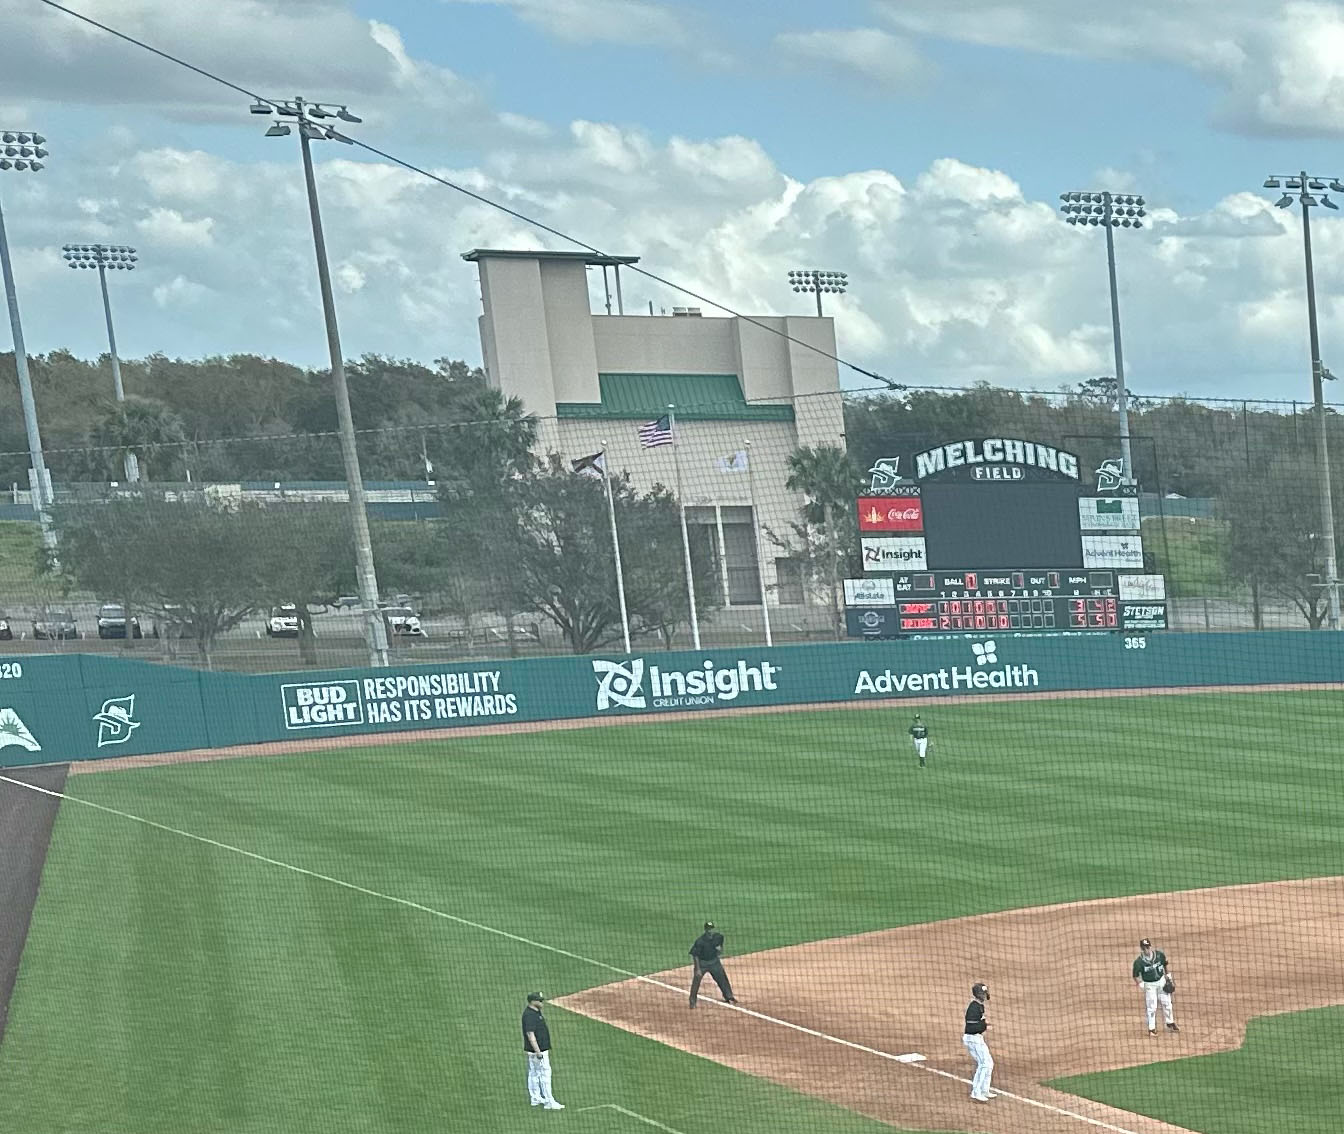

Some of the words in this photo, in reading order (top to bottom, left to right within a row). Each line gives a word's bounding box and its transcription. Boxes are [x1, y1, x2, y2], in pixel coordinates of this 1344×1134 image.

[917, 438, 1079, 479] MELCHING
[975, 467, 1021, 479] FIELD
[888, 508, 921, 520] Coca-Cola
[881, 549, 923, 561] Insight
[944, 578, 964, 586] BALL
[1123, 606, 1165, 617] STETSON
[1124, 637, 1146, 649] 365
[363, 670, 501, 700] RESPONSIBILITY
[649, 660, 778, 700] Insight
[296, 686, 347, 706] BUD
[653, 697, 685, 708] CREDIT
[685, 696, 714, 706] UNION
[288, 702, 357, 724] LIGHT
[367, 702, 401, 724] HAS
[405, 699, 432, 721] ITS
[435, 694, 518, 719] REWARDS
